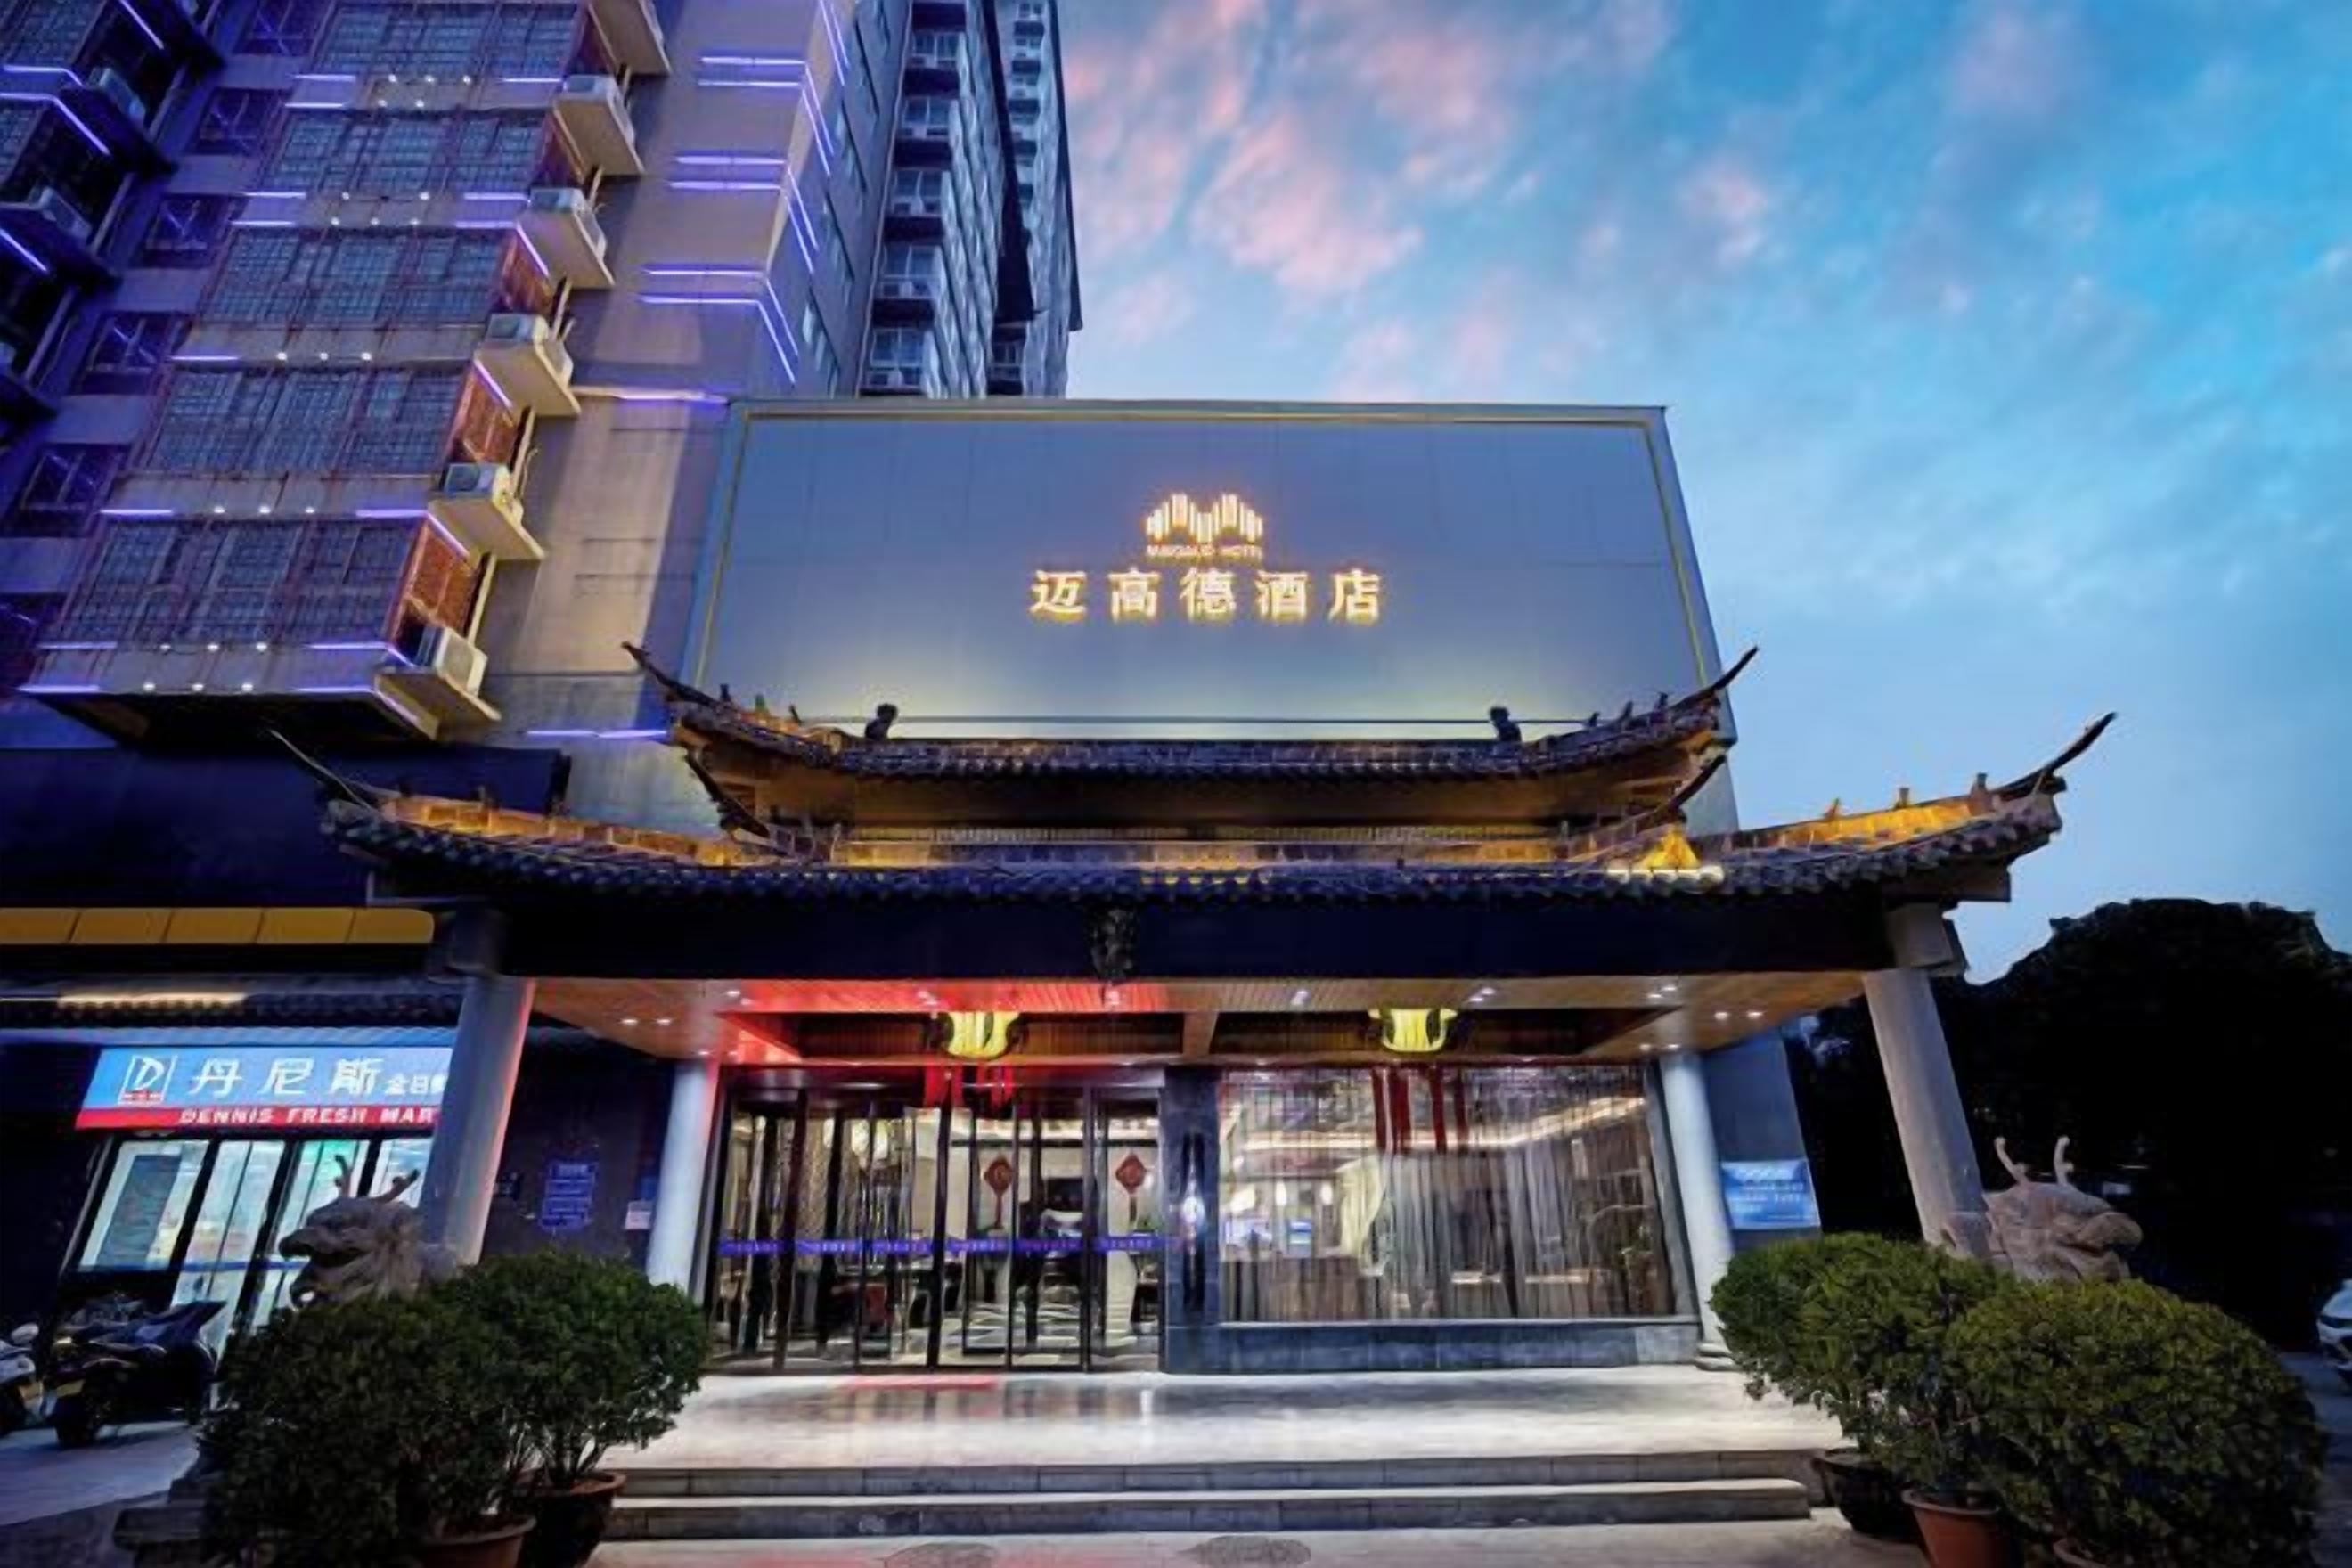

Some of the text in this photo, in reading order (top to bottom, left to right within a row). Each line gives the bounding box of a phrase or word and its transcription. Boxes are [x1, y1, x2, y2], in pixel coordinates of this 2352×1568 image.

[1030, 568, 1380, 622] 迈高德酒店
[188, 1058, 384, 1097] 丹尼斯
[178, 1107, 273, 1124] DENNIS
[286, 1107, 368, 1123] FRESH
